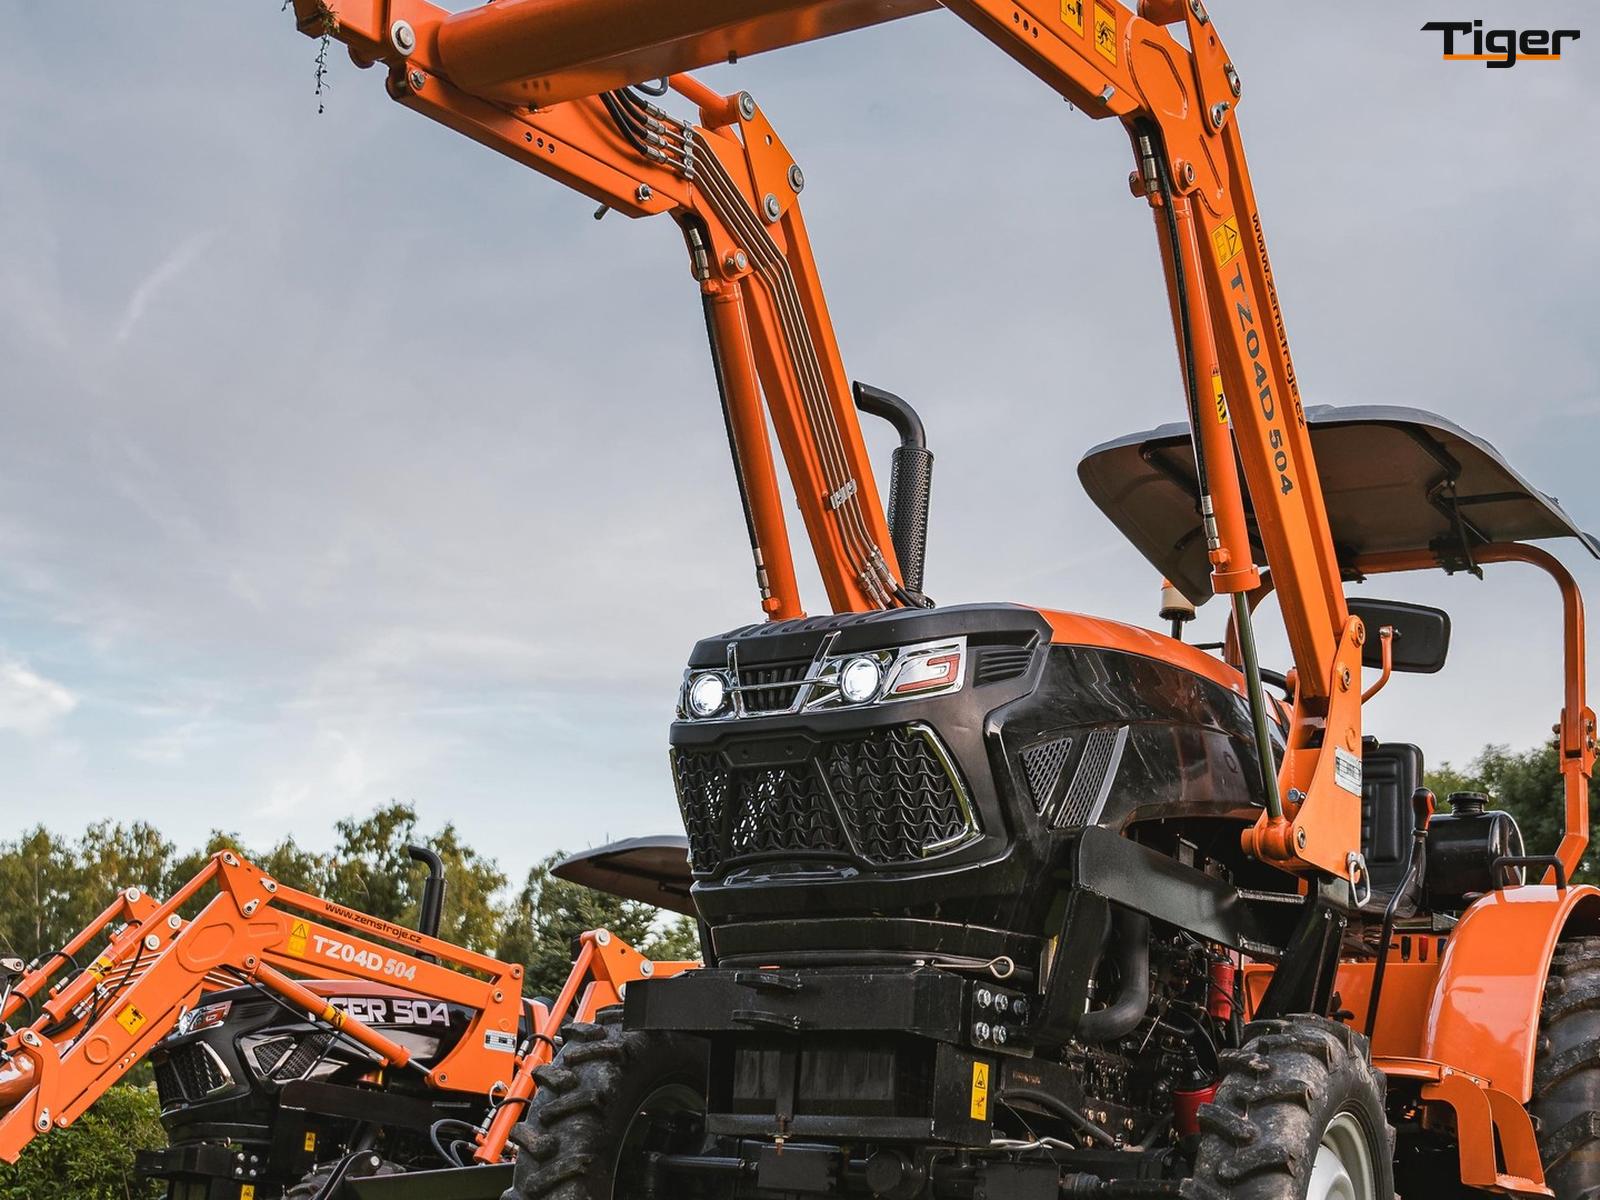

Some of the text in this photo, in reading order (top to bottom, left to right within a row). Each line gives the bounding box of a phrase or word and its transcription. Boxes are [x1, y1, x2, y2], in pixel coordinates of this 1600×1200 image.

[1251, 211, 1305, 429] www.zemstroje.cz
[1230, 262, 1294, 496] TZ04D 504
[325, 903, 423, 943] www.zemstroje.cz
[312, 934, 417, 982] TZ04D 504
[392, 999, 451, 1027] 504
